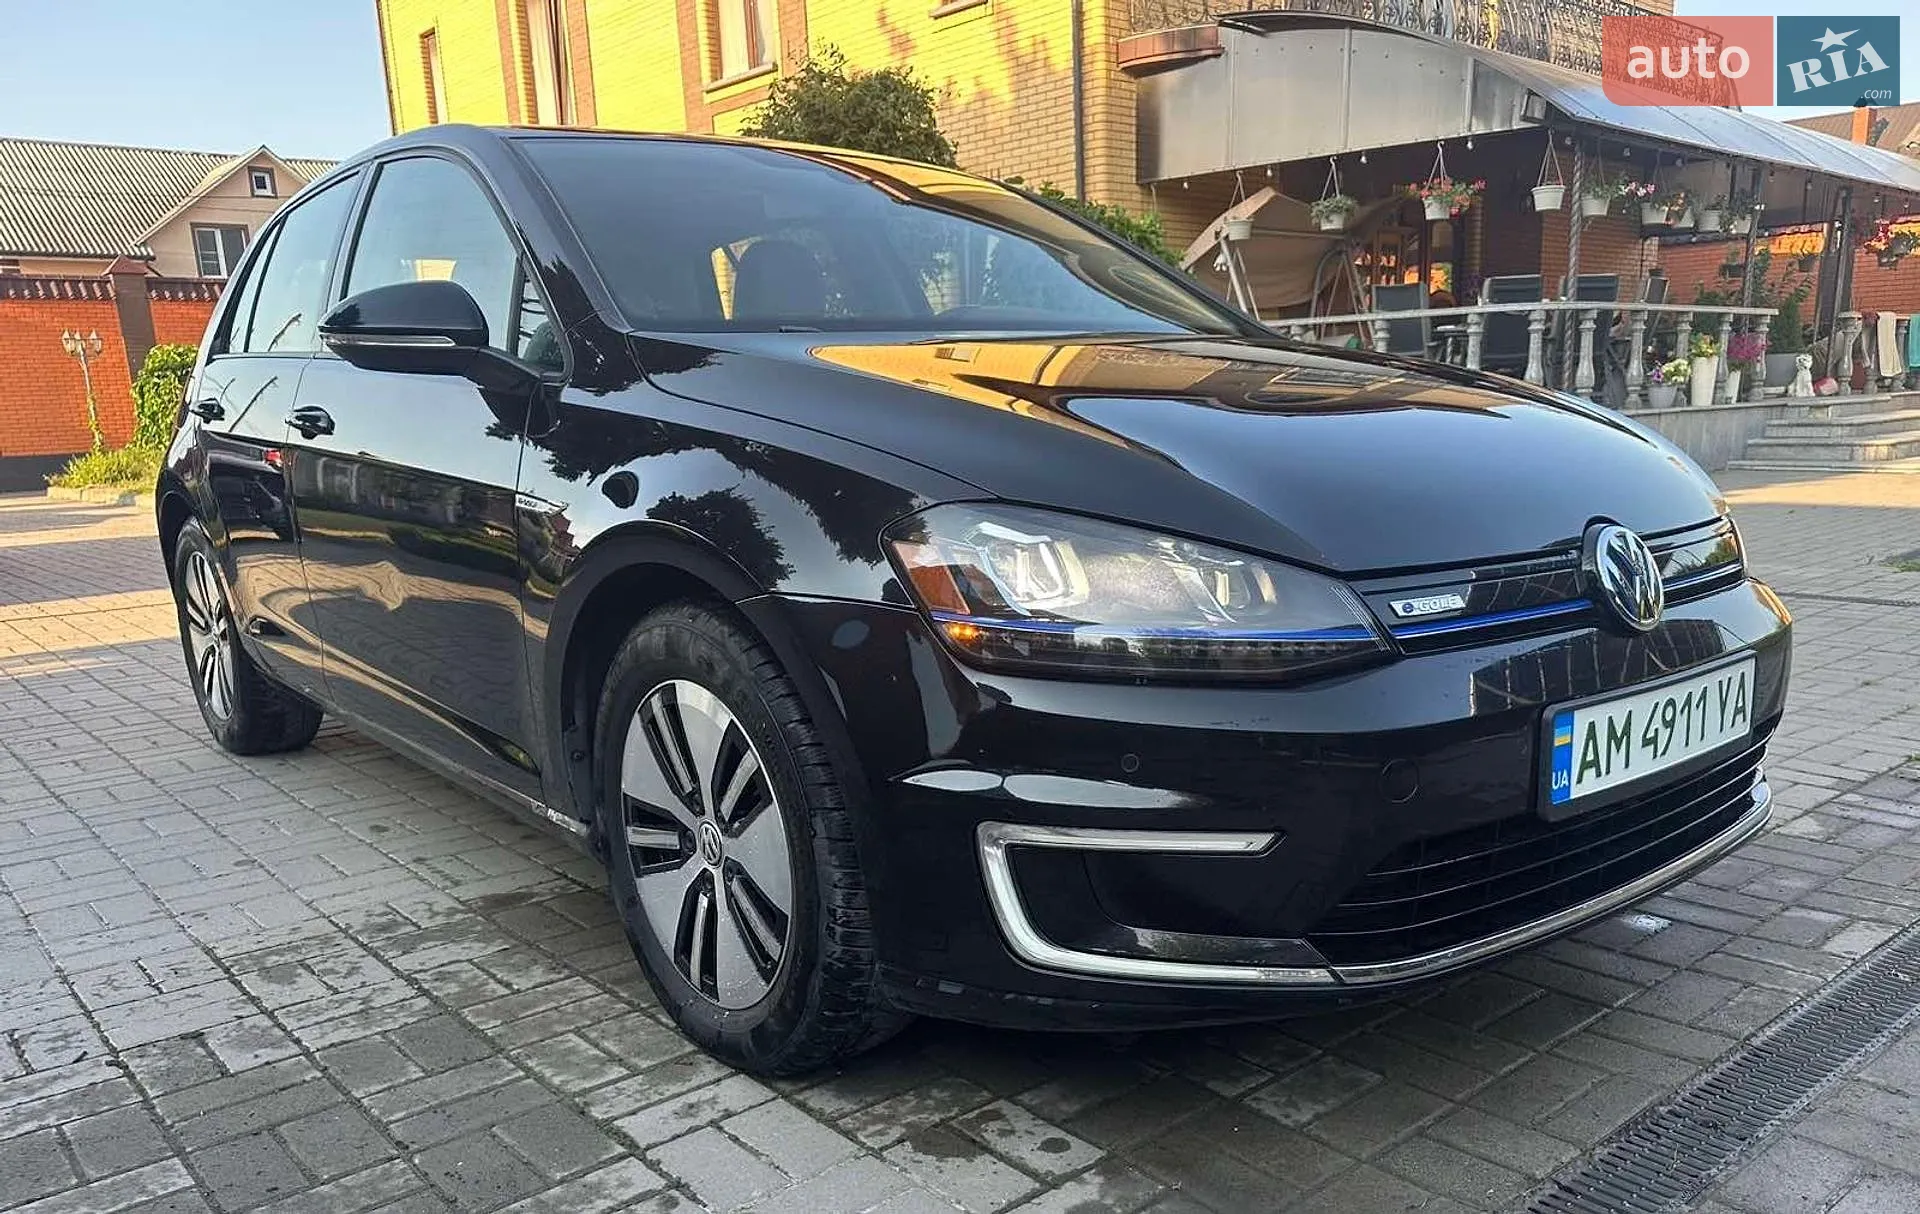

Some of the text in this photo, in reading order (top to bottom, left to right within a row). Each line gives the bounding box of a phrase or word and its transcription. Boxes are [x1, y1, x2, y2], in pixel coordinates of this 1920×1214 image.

[1575, 671, 1747, 785] AM 4911 YA
[1552, 770, 1570, 790] UA
